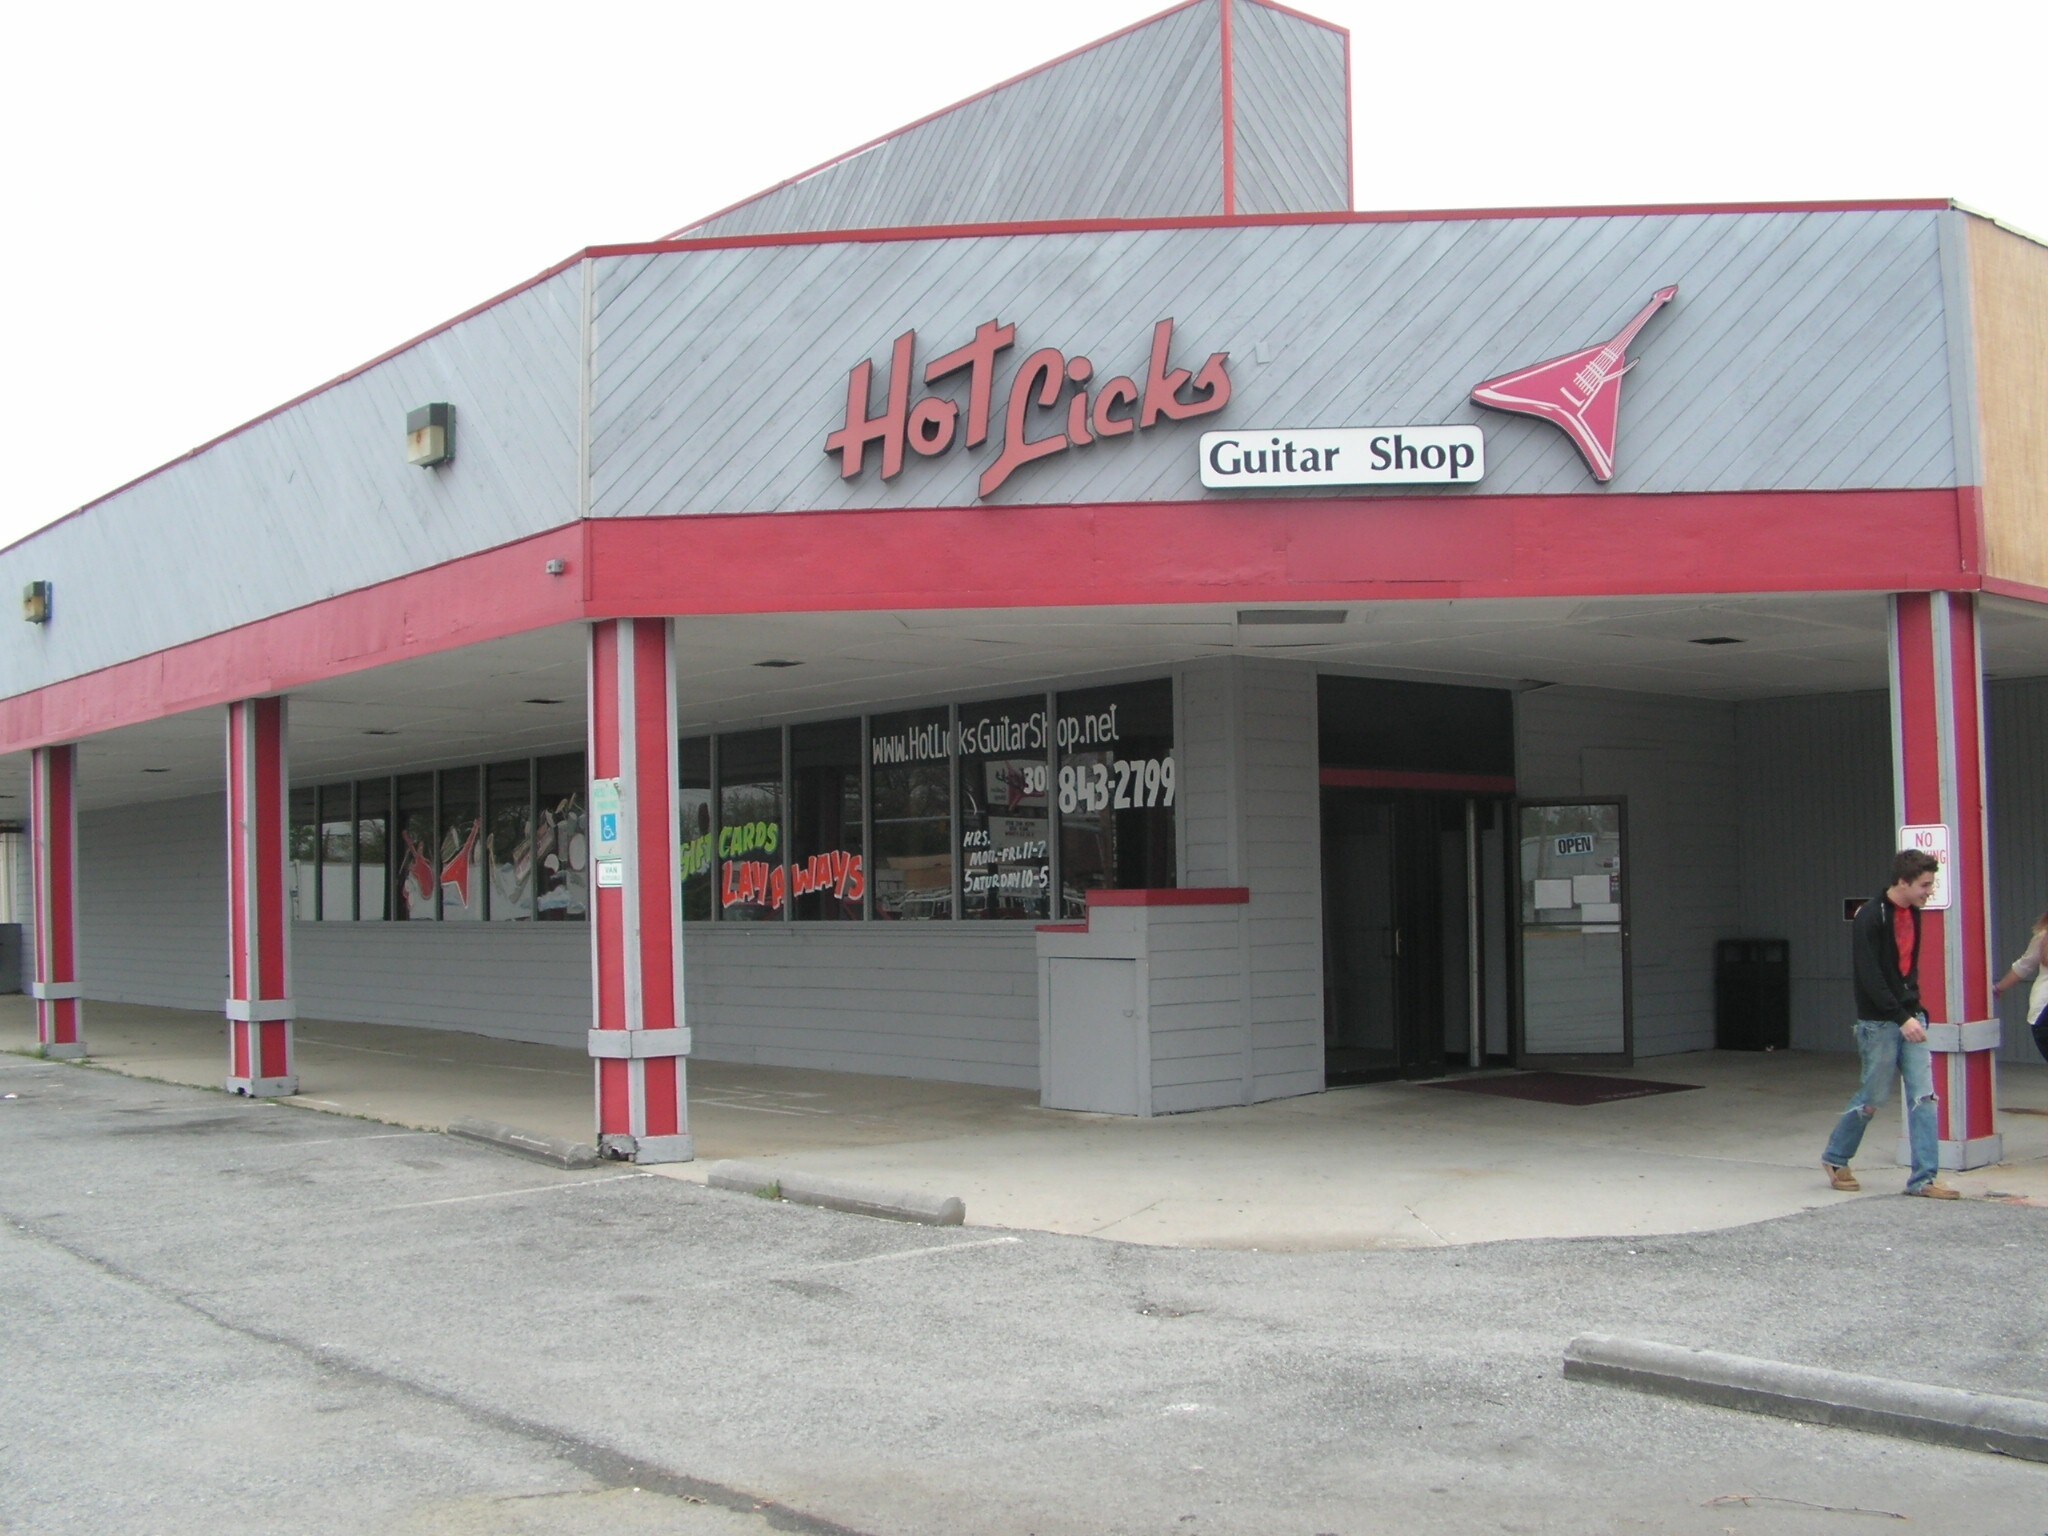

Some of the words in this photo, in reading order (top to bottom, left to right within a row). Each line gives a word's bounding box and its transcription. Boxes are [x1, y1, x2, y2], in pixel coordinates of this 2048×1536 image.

[978, 317, 1231, 499] Licks
[1209, 437, 1340, 475] Guitar
[1370, 434, 1475, 480] Shop
[1058, 756, 1176, 814] 843-2799
[718, 821, 779, 859] CARDS
[963, 829, 991, 848] HRS.
[1557, 836, 1592, 855] OPEN
[1915, 832, 1933, 848] NO
[963, 869, 1021, 893] SATURDAY
[1020, 865, 1049, 889] 10-5
